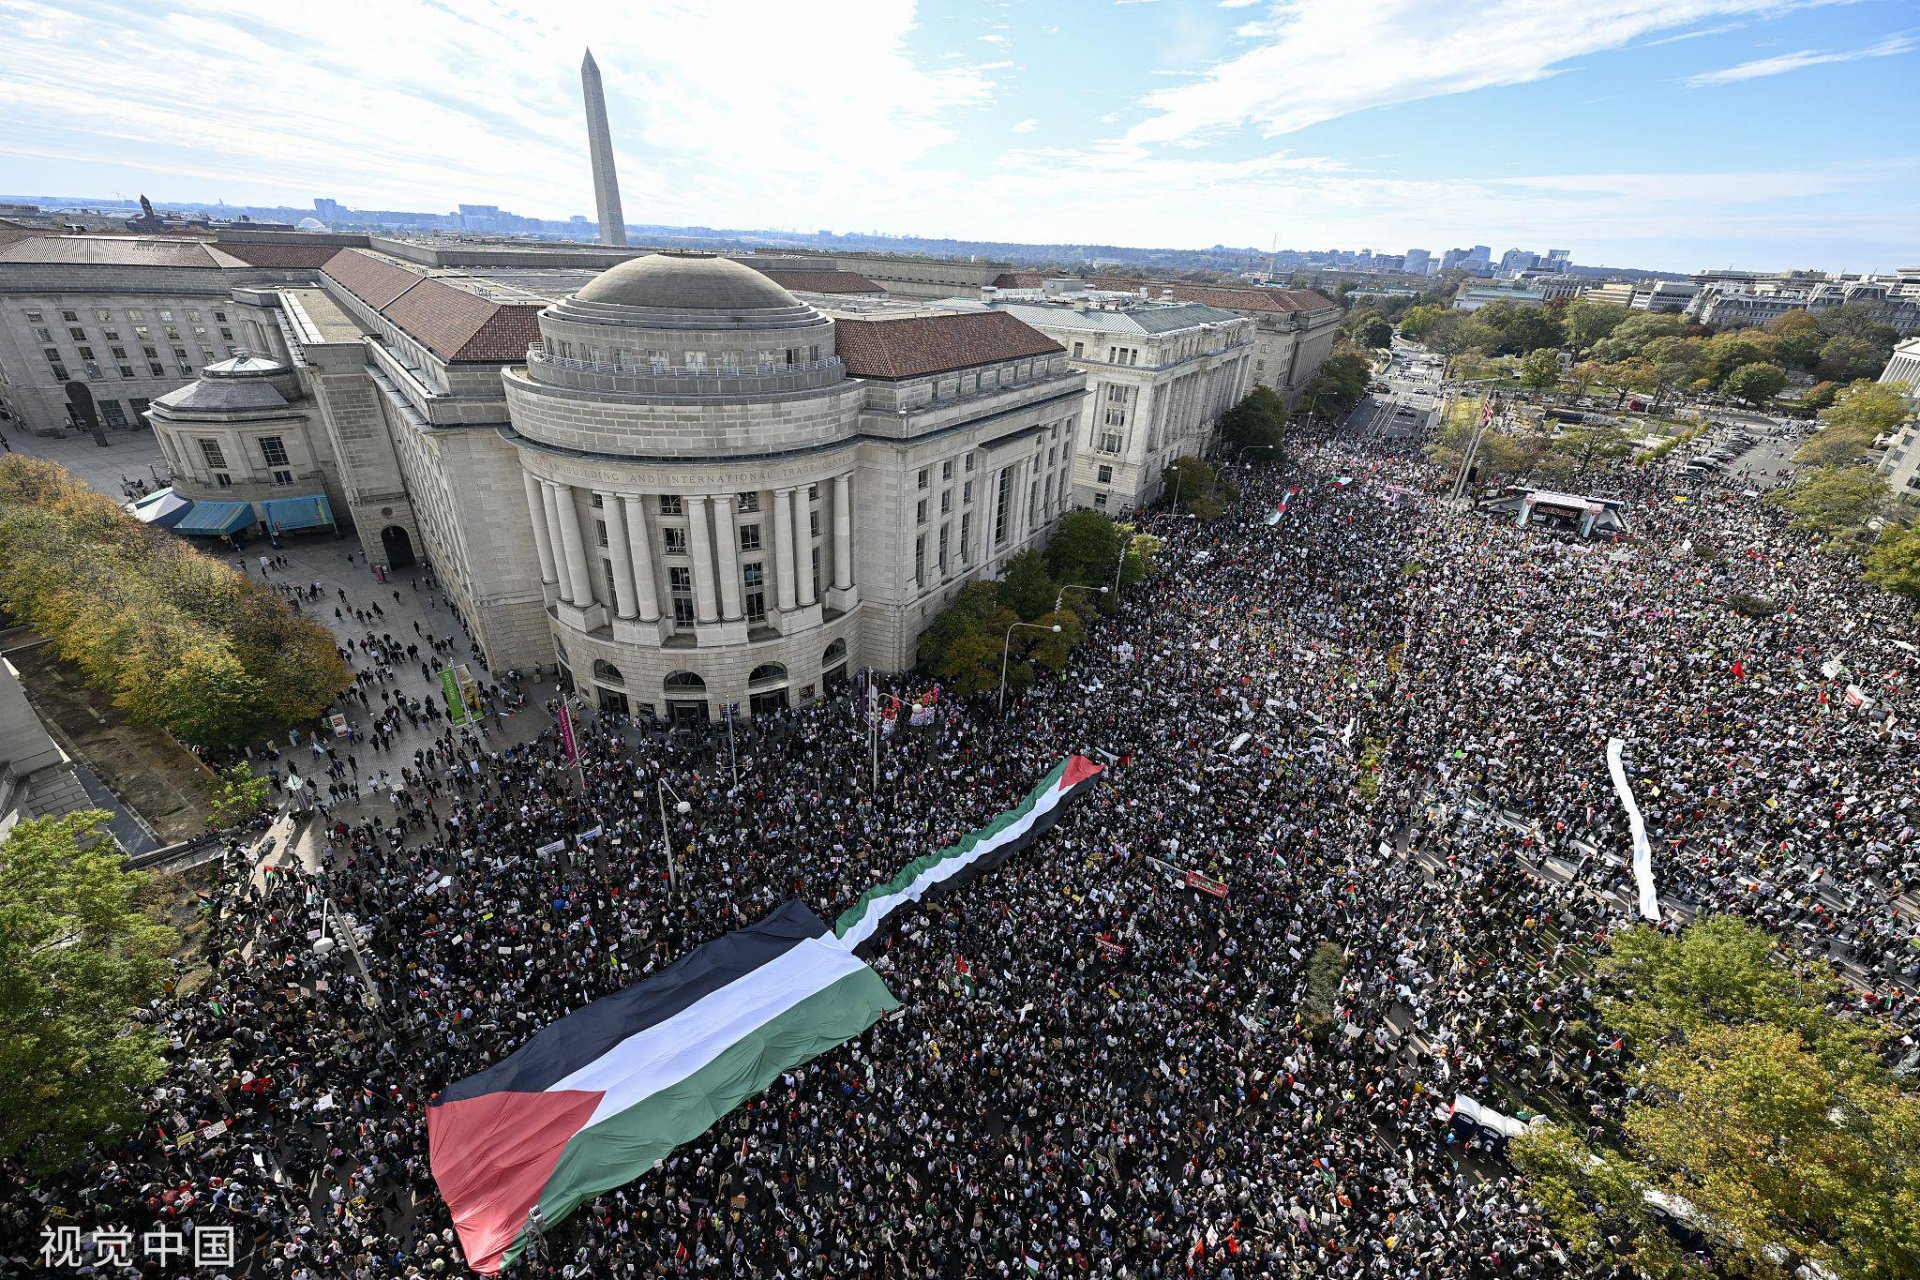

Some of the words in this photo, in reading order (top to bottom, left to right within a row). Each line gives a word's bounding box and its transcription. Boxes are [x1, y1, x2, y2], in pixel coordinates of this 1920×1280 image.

[566, 466, 619, 481] BUILDING
[630, 474, 655, 483] AND
[667, 469, 771, 484] INTERNATIONAL
[783, 464, 815, 477] TRADE
[822, 454, 851, 469] CENTER
